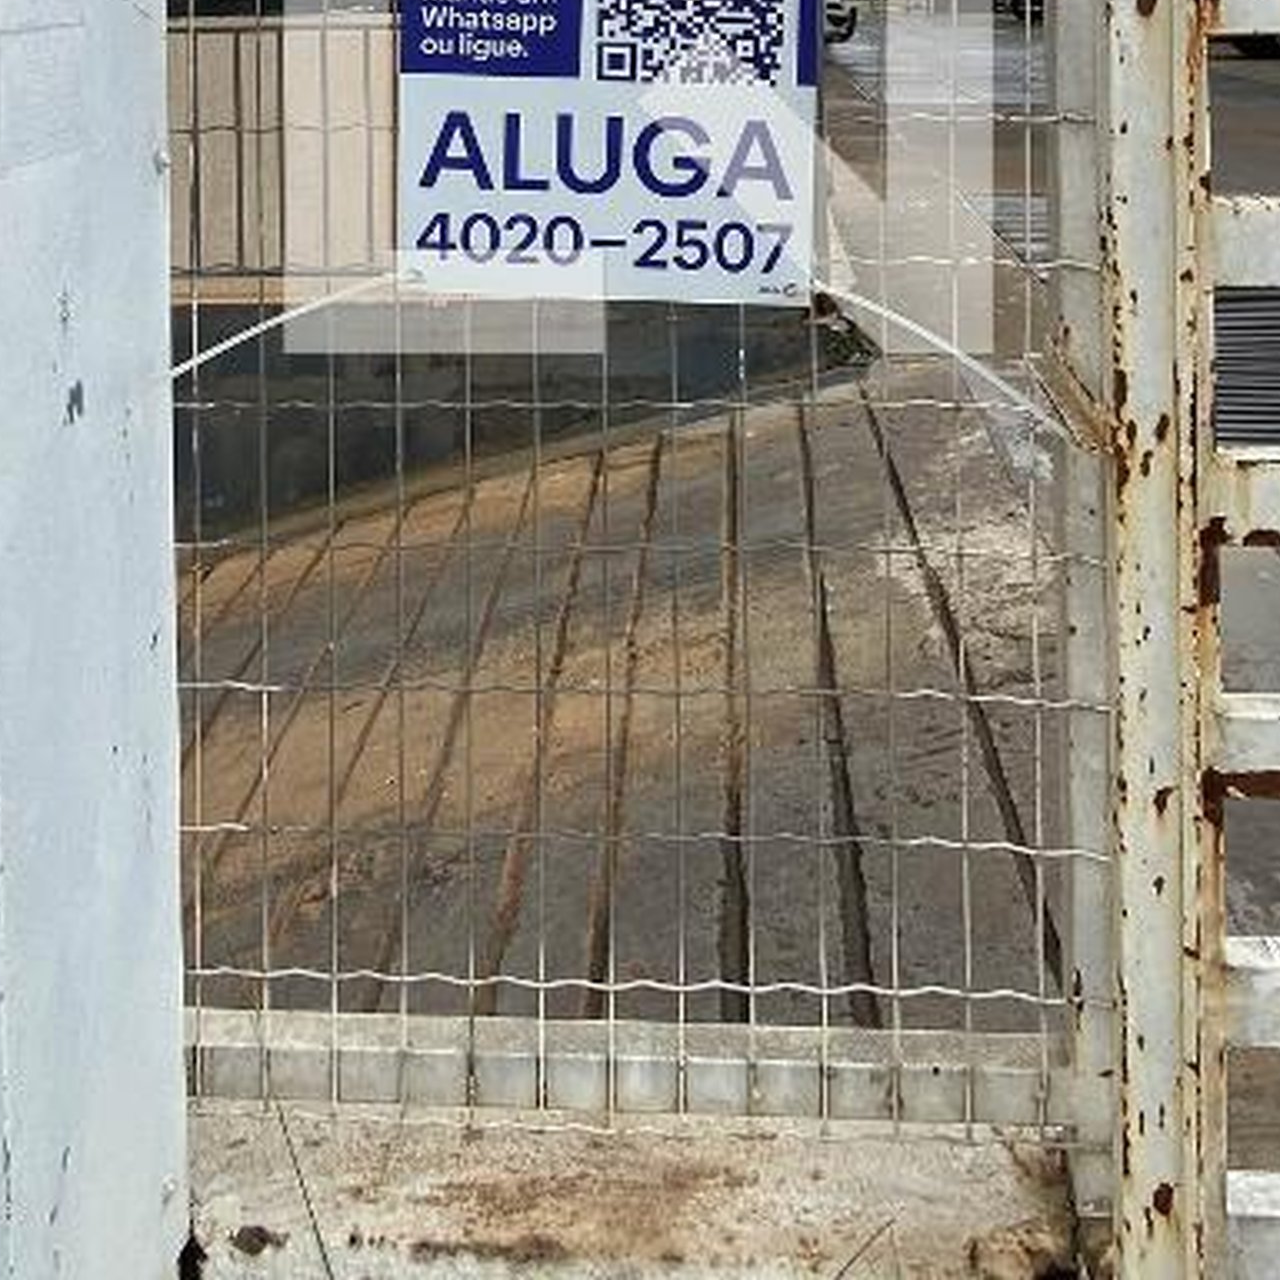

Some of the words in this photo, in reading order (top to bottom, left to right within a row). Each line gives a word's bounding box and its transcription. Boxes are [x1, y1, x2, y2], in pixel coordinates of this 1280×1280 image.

[421, 5, 558, 37] Whatsapp
[419, 36, 454, 55] ou
[459, 32, 529, 61] ligue.
[419, 109, 794, 201] ALUGA
[415, 211, 794, 276] 4020-2507
